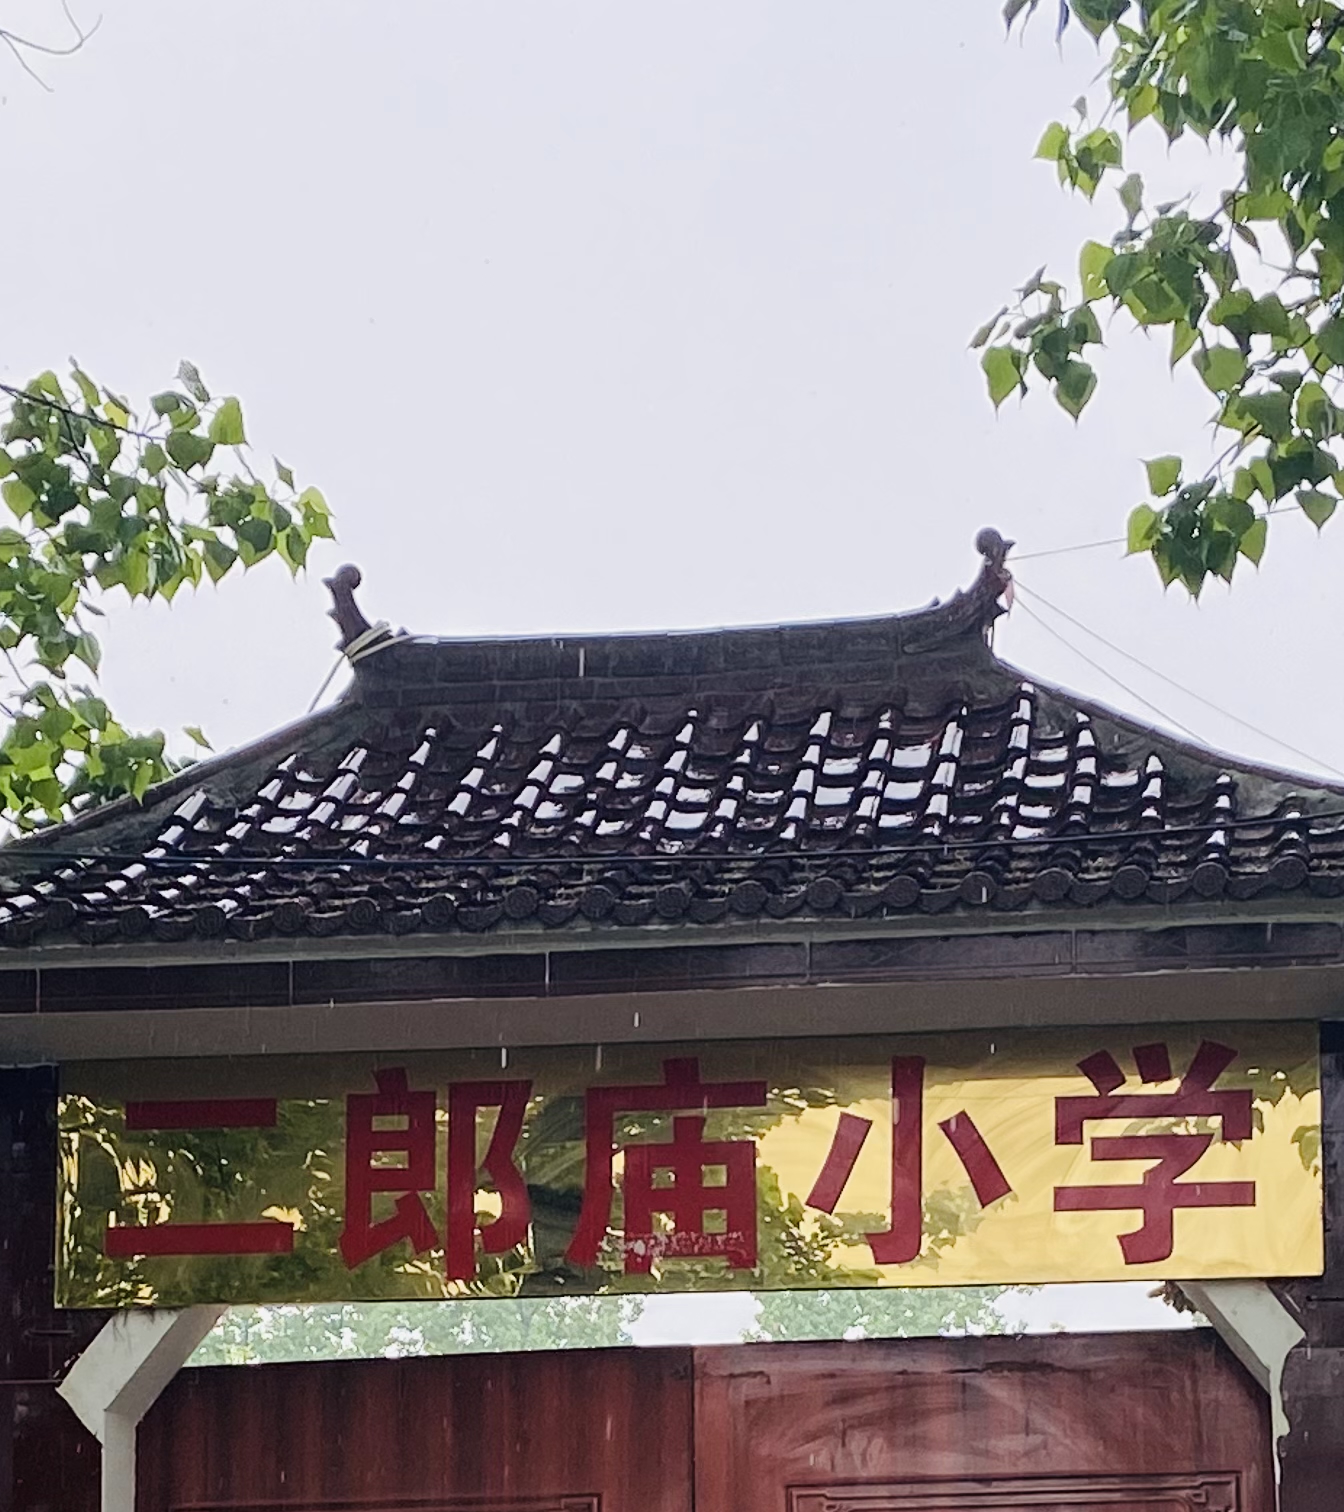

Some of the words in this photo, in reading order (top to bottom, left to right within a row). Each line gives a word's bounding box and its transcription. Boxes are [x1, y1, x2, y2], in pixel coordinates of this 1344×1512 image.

[106, 1039, 1256, 1281] 二郎庙小学
